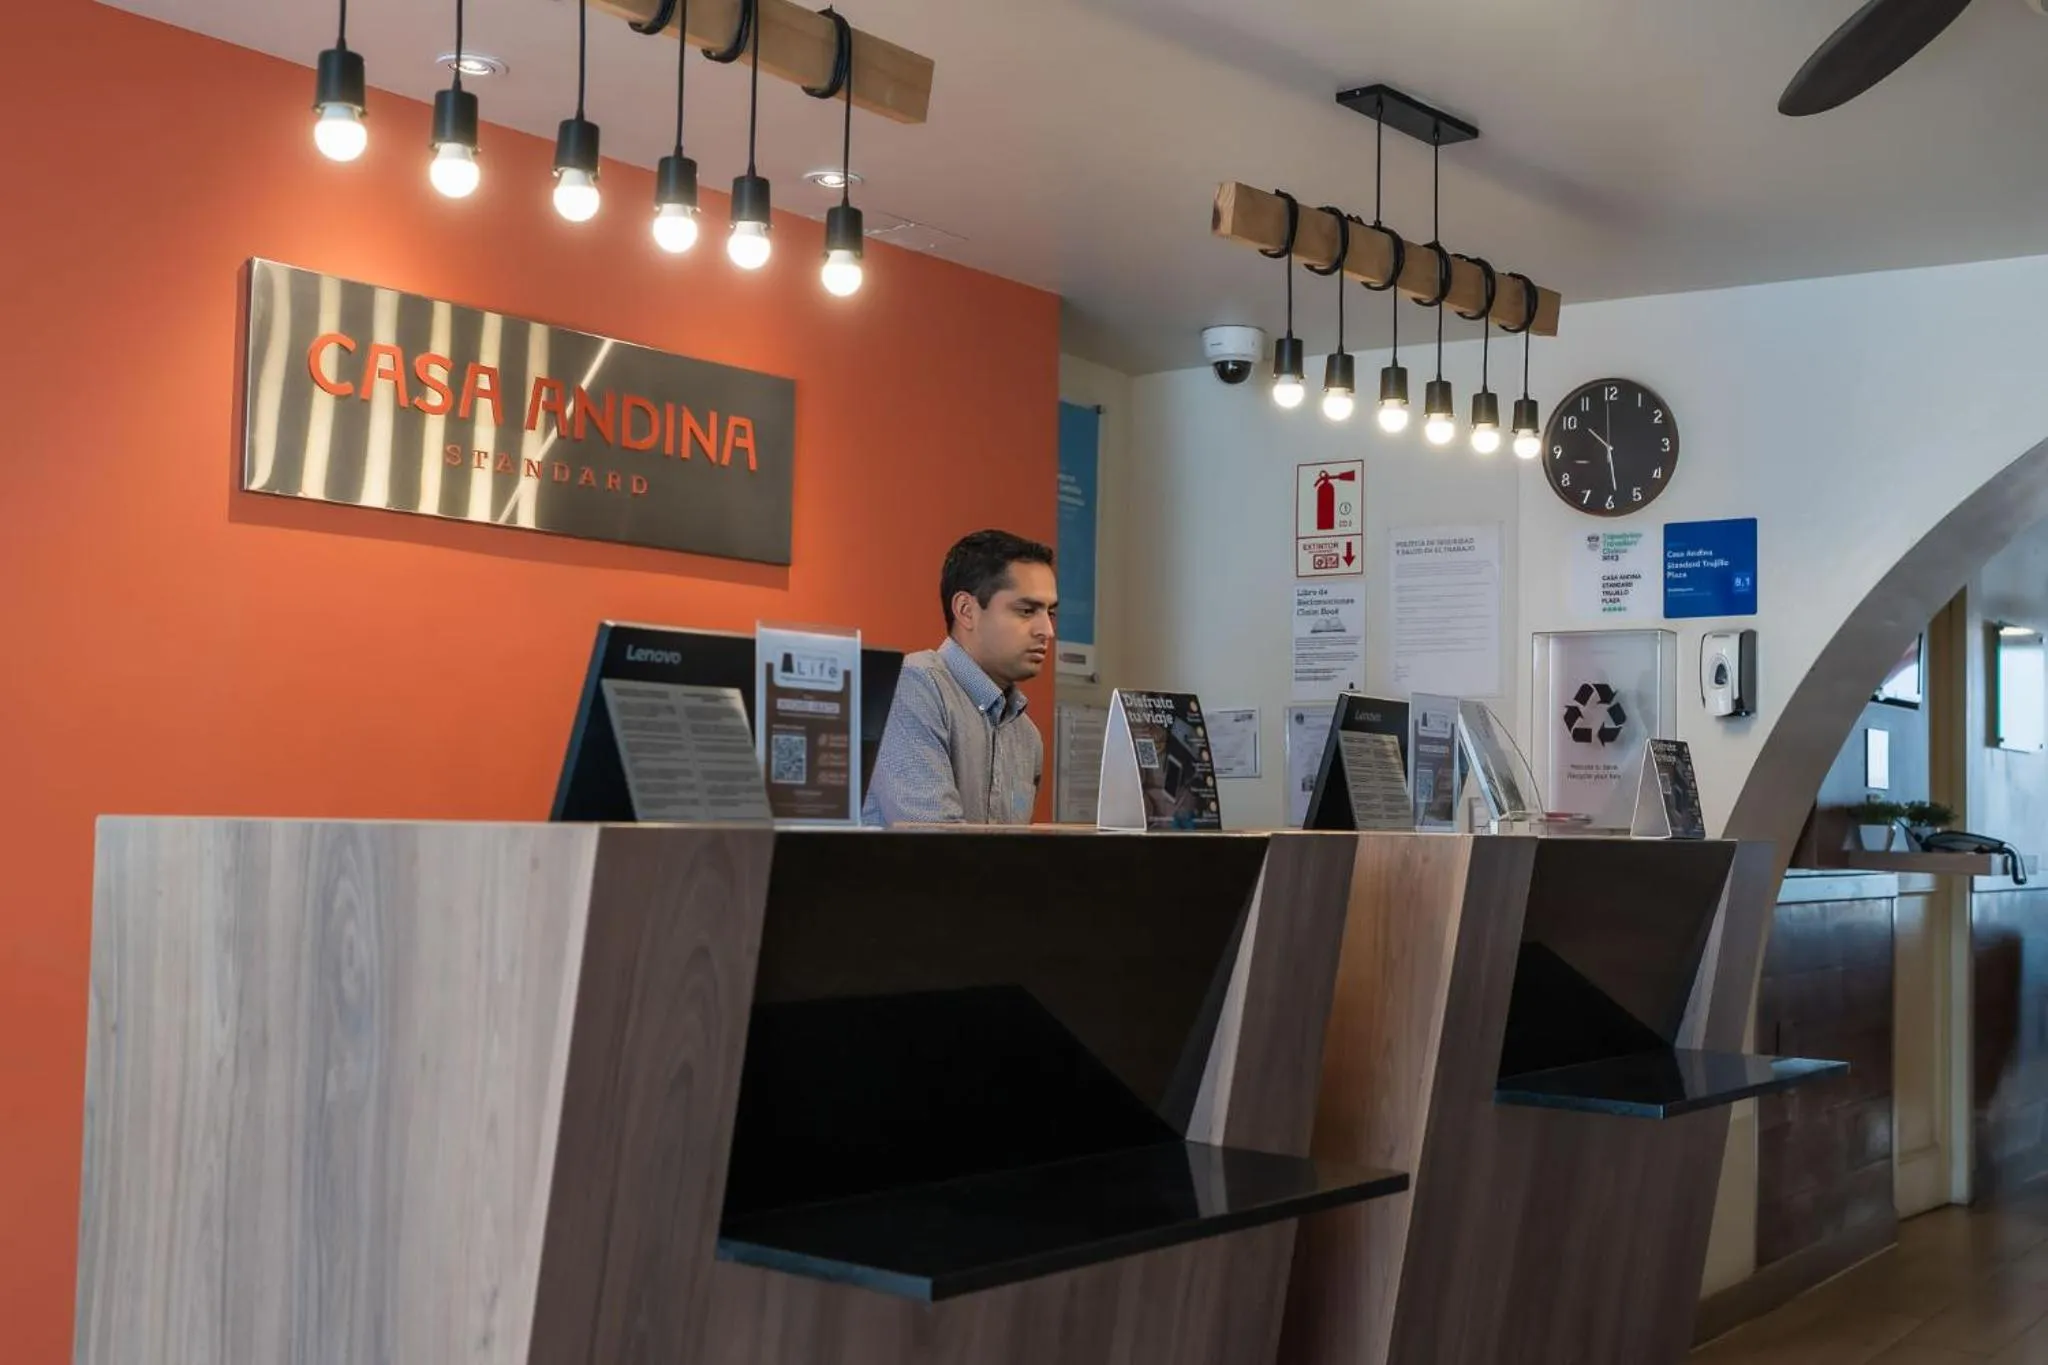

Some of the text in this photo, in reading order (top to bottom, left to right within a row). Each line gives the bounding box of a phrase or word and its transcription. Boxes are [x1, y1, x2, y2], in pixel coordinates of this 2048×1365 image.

[1605, 386, 1618, 401] 12
[1638, 392, 1642, 408] 1
[308, 332, 758, 472] CASA ANDINA
[1581, 396, 1589, 412] 11
[1563, 415, 1578, 430] 10
[1653, 409, 1663, 424] 2
[1661, 437, 1670, 452] 3
[1553, 445, 1562, 460] 9
[445, 444, 649, 495] STANDARD
[1652, 467, 1661, 479] 4
[1561, 472, 1570, 487] 8
[1582, 489, 1592, 504] 7
[1632, 487, 1642, 501] 5
[1605, 495, 1615, 510] 6
[1303, 542, 1339, 551] EXTINTOR
[1667, 548, 1713, 558] Casa Andina
[1667, 558, 1730, 570] Standard Trujillo
[1666, 571, 1688, 579] Plaza
[1602, 581, 1633, 589] STANDARD
[1602, 589, 1630, 597] TRUJILLO
[626, 644, 682, 665] Lenovo
[1123, 693, 1175, 709] Disfruta
[1127, 711, 1140, 723] tu
[1142, 709, 1174, 728] viaje
